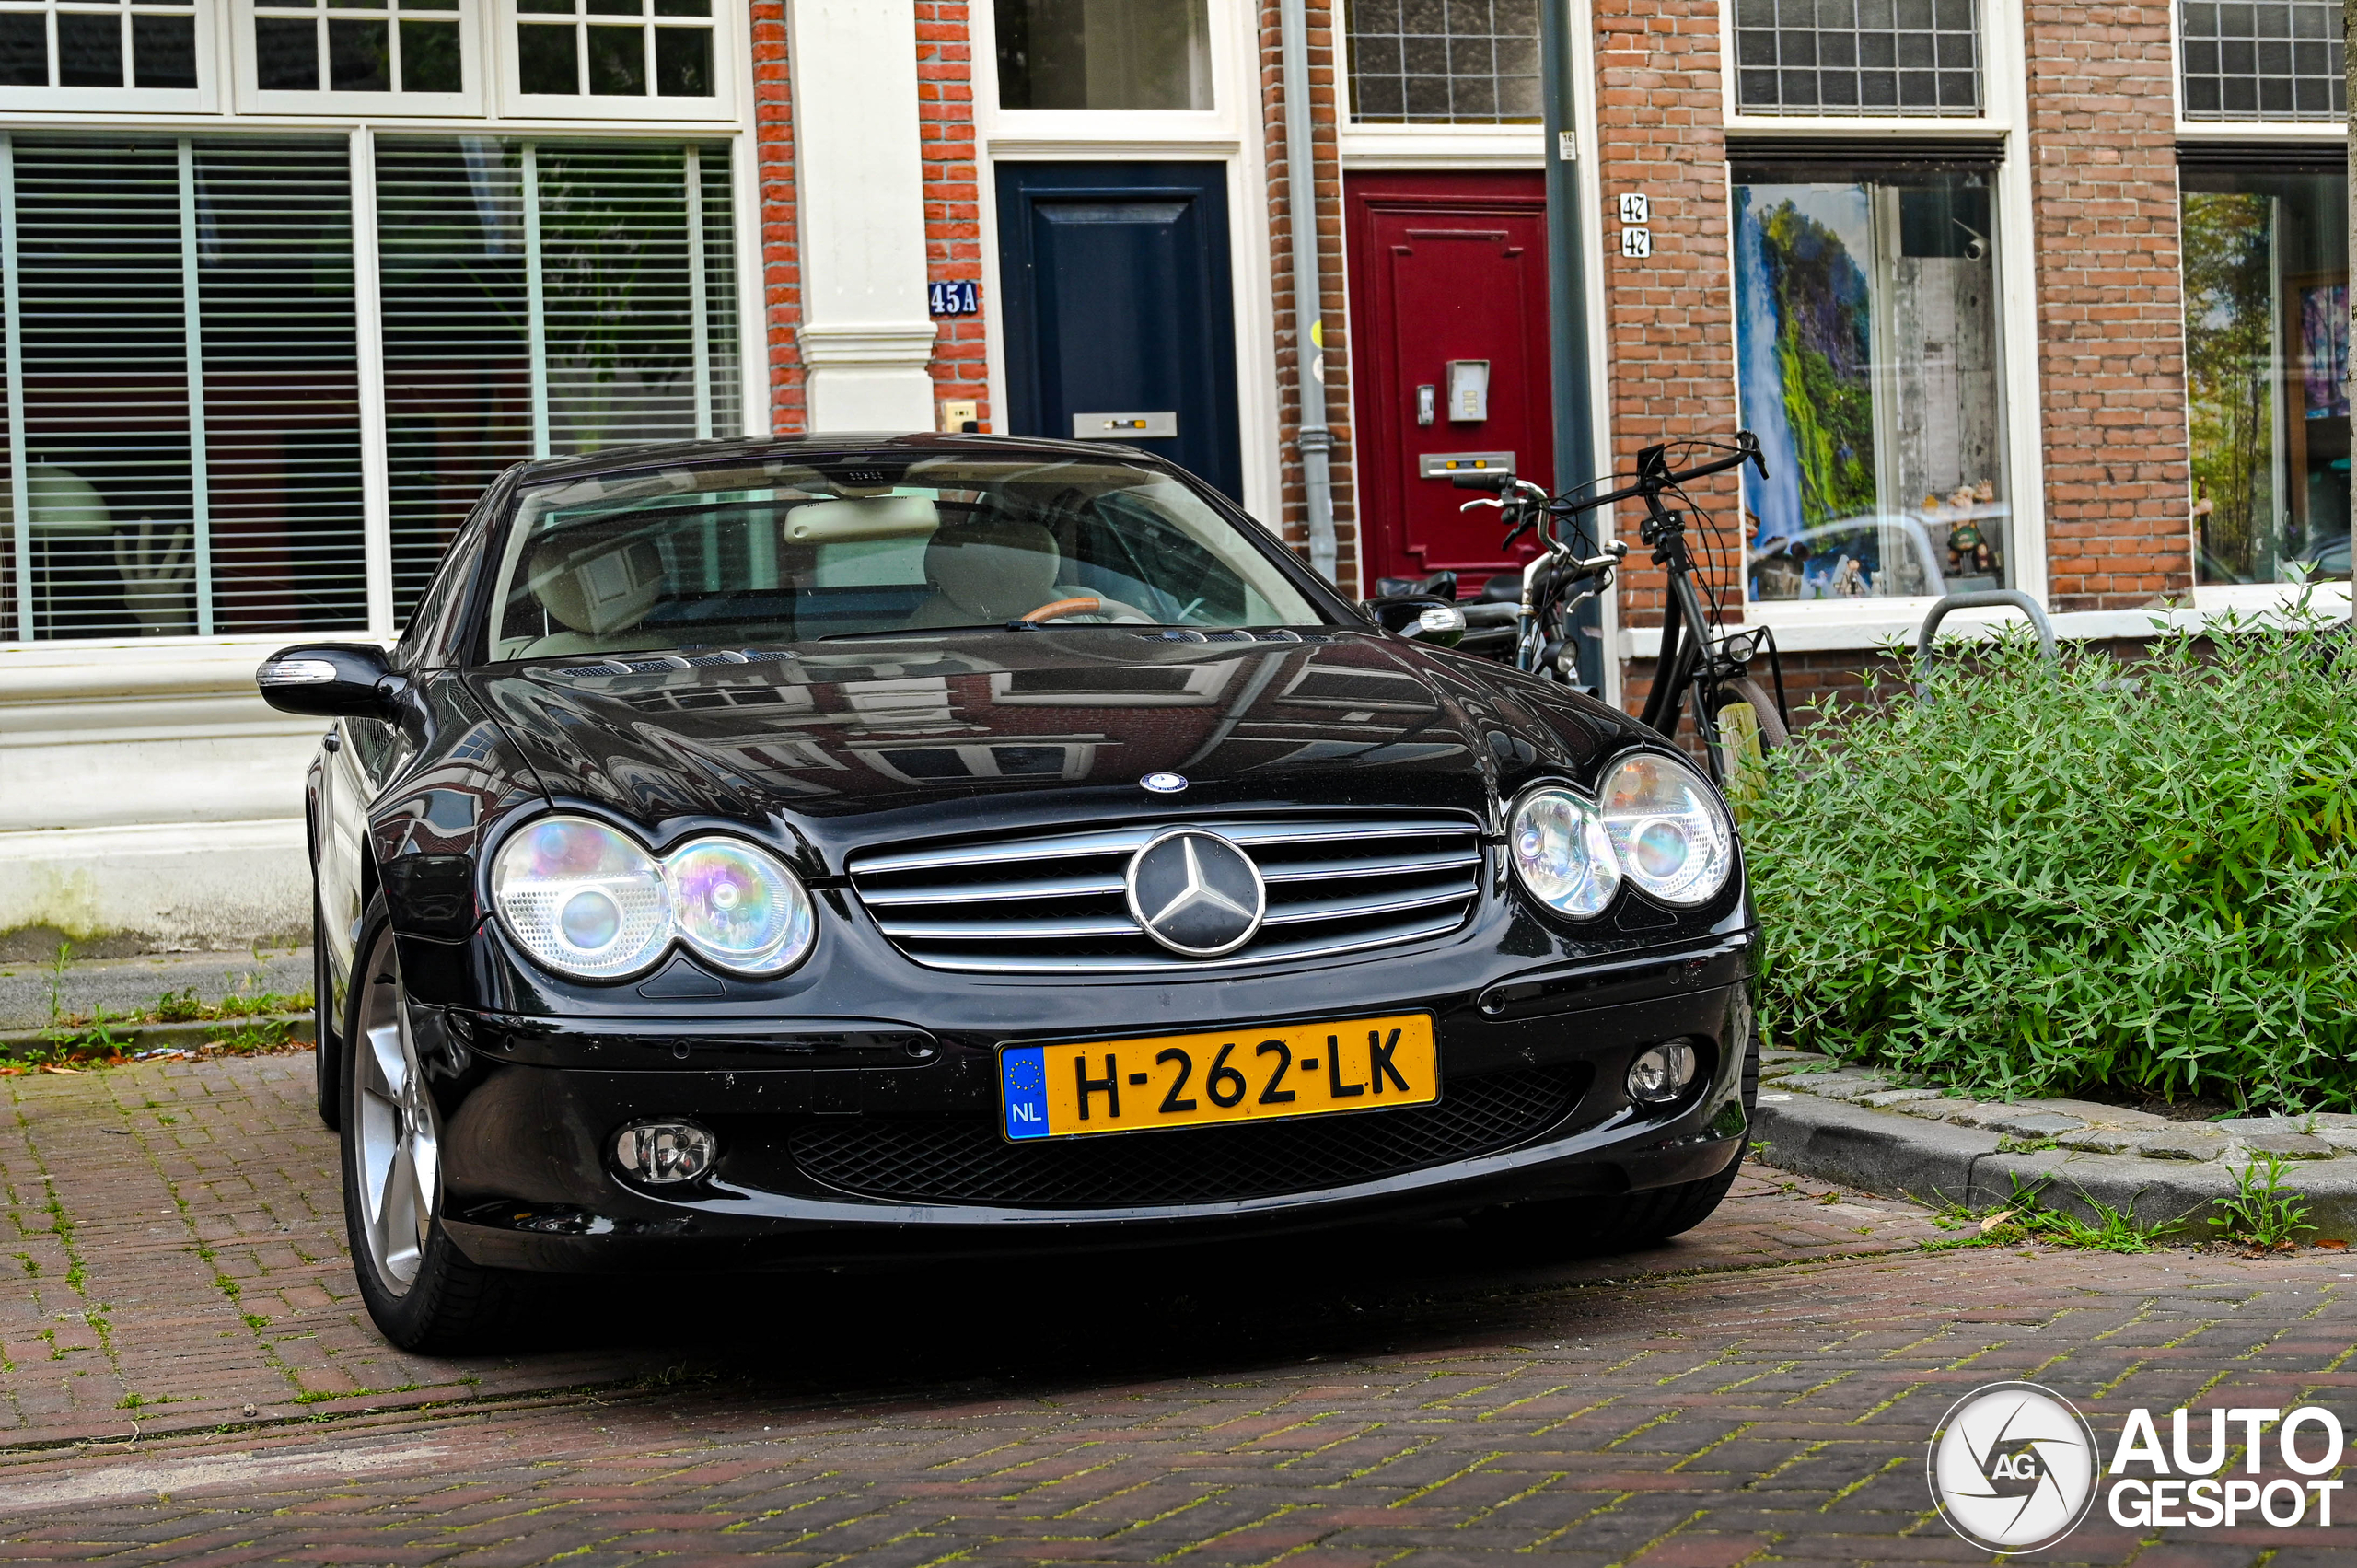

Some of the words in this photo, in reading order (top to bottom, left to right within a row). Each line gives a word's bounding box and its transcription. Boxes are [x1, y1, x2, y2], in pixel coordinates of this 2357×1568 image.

[1563, 134, 1573, 143] 16
[1623, 195, 1644, 221] 47
[1625, 229, 1647, 255] 47
[931, 284, 977, 313] 45A
[1074, 1028, 1411, 1121] H-262-LK
[1012, 1102, 1042, 1123] NL
